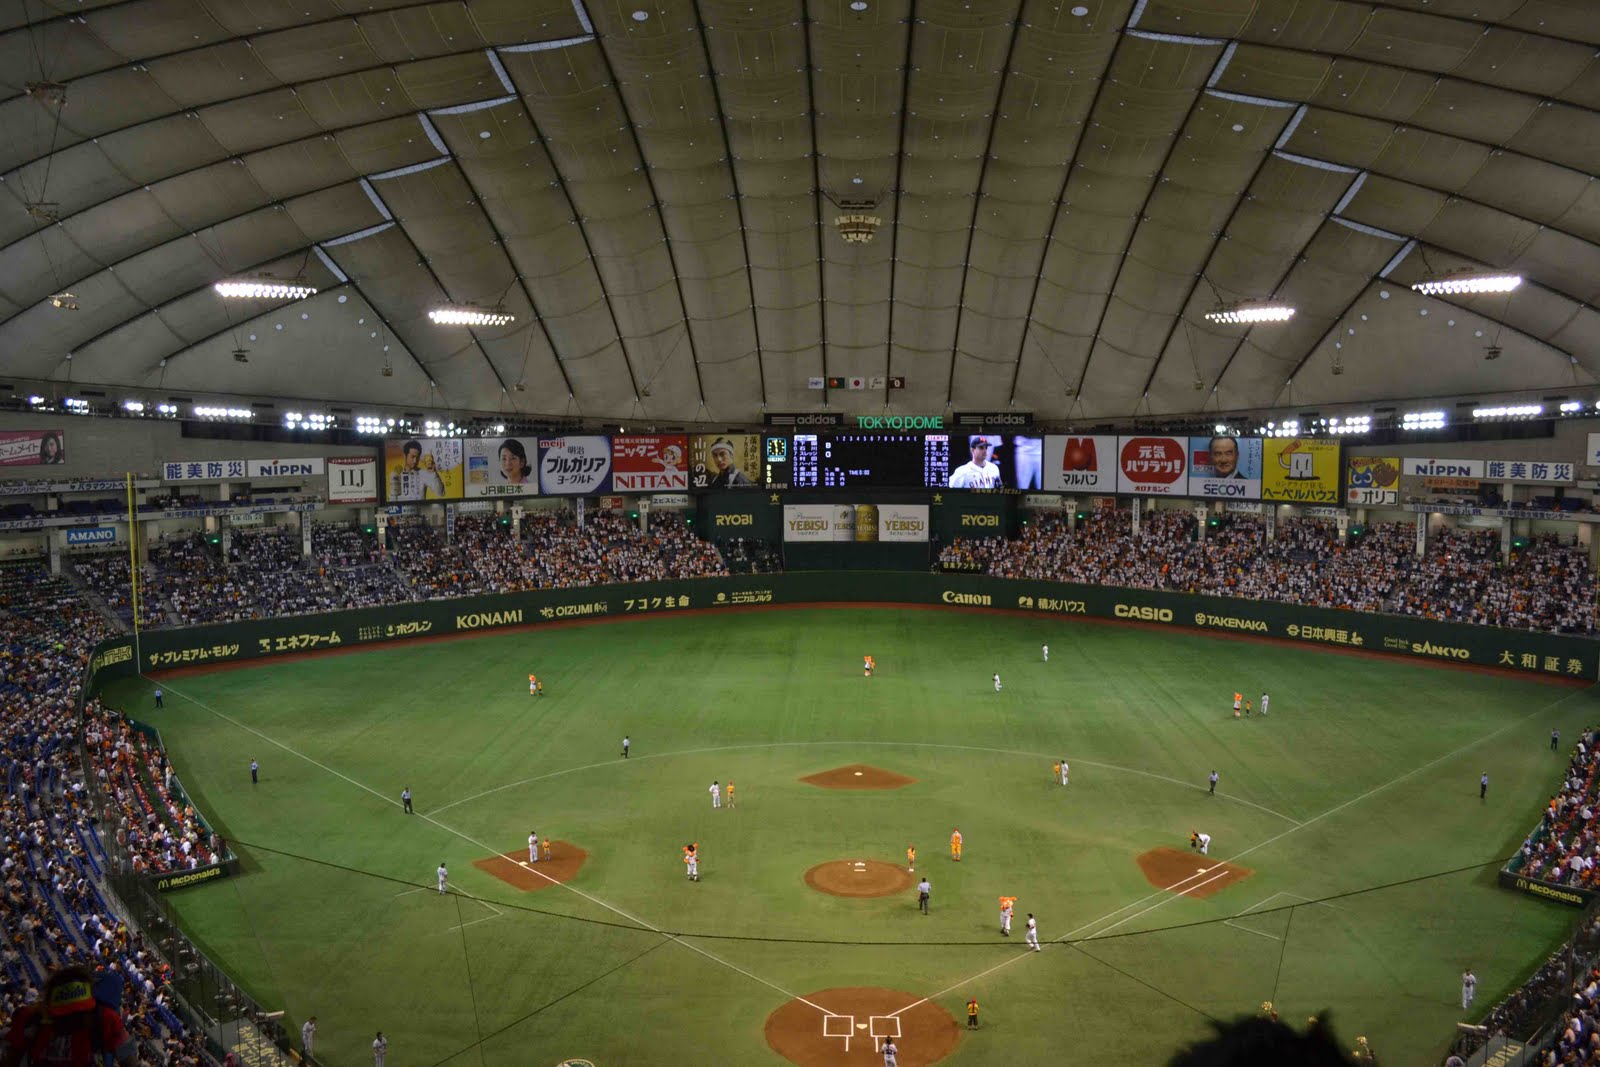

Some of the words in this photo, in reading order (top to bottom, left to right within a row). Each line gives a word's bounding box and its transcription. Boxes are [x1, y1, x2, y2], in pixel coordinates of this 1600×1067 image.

[797, 415, 836, 425] adidas
[857, 416, 902, 429] TOKYO
[904, 416, 943, 429] DOME
[985, 415, 1025, 425] adidas
[540, 438, 566, 449] meiji
[567, 446, 585, 455] 明治
[613, 445, 659, 457] ニッタン
[1139, 445, 1166, 460] 元気
[166, 462, 244, 479] 能美防災
[546, 456, 606, 474] ブルガリア
[1488, 461, 1571, 480] 能美防災
[338, 469, 366, 487] IIJ
[557, 473, 595, 485] ヨーグルト
[615, 474, 686, 489] NITTAN
[1063, 474, 1098, 486] マルハン
[480, 485, 524, 496] JR東日本
[1203, 484, 1246, 496] SECOM
[1263, 488, 1338, 502] ヘーベルハウス
[1362, 490, 1398, 505] オリコ
[715, 514, 753, 526] RYOBI
[788, 520, 829, 531] YEBISU
[884, 520, 924, 531] YEBISU
[961, 514, 999, 526] RYOBI
[69, 530, 114, 541] AMANO
[624, 595, 690, 611] フコク生命
[731, 594, 772, 604] コニカミノルタ
[942, 590, 992, 605] Canon
[556, 602, 593, 618] OIZUMI
[1038, 598, 1086, 613] 積水ハウス
[1114, 604, 1173, 622] CASIO
[457, 609, 522, 629] KONAMI
[1206, 615, 1268, 632] TAKENAKA
[396, 621, 432, 634] ホクレン
[1302, 625, 1348, 643] 日本興亜
[275, 631, 341, 651] エネファーム
[105, 646, 131, 664] THK
[150, 643, 240, 665] ザ・プレミアム・モルツ
[1412, 640, 1470, 659] SANKYO
[1499, 650, 1583, 675] 大和証券
[171, 867, 220, 885] McDonald's
[1529, 882, 1583, 904] McDonald's
